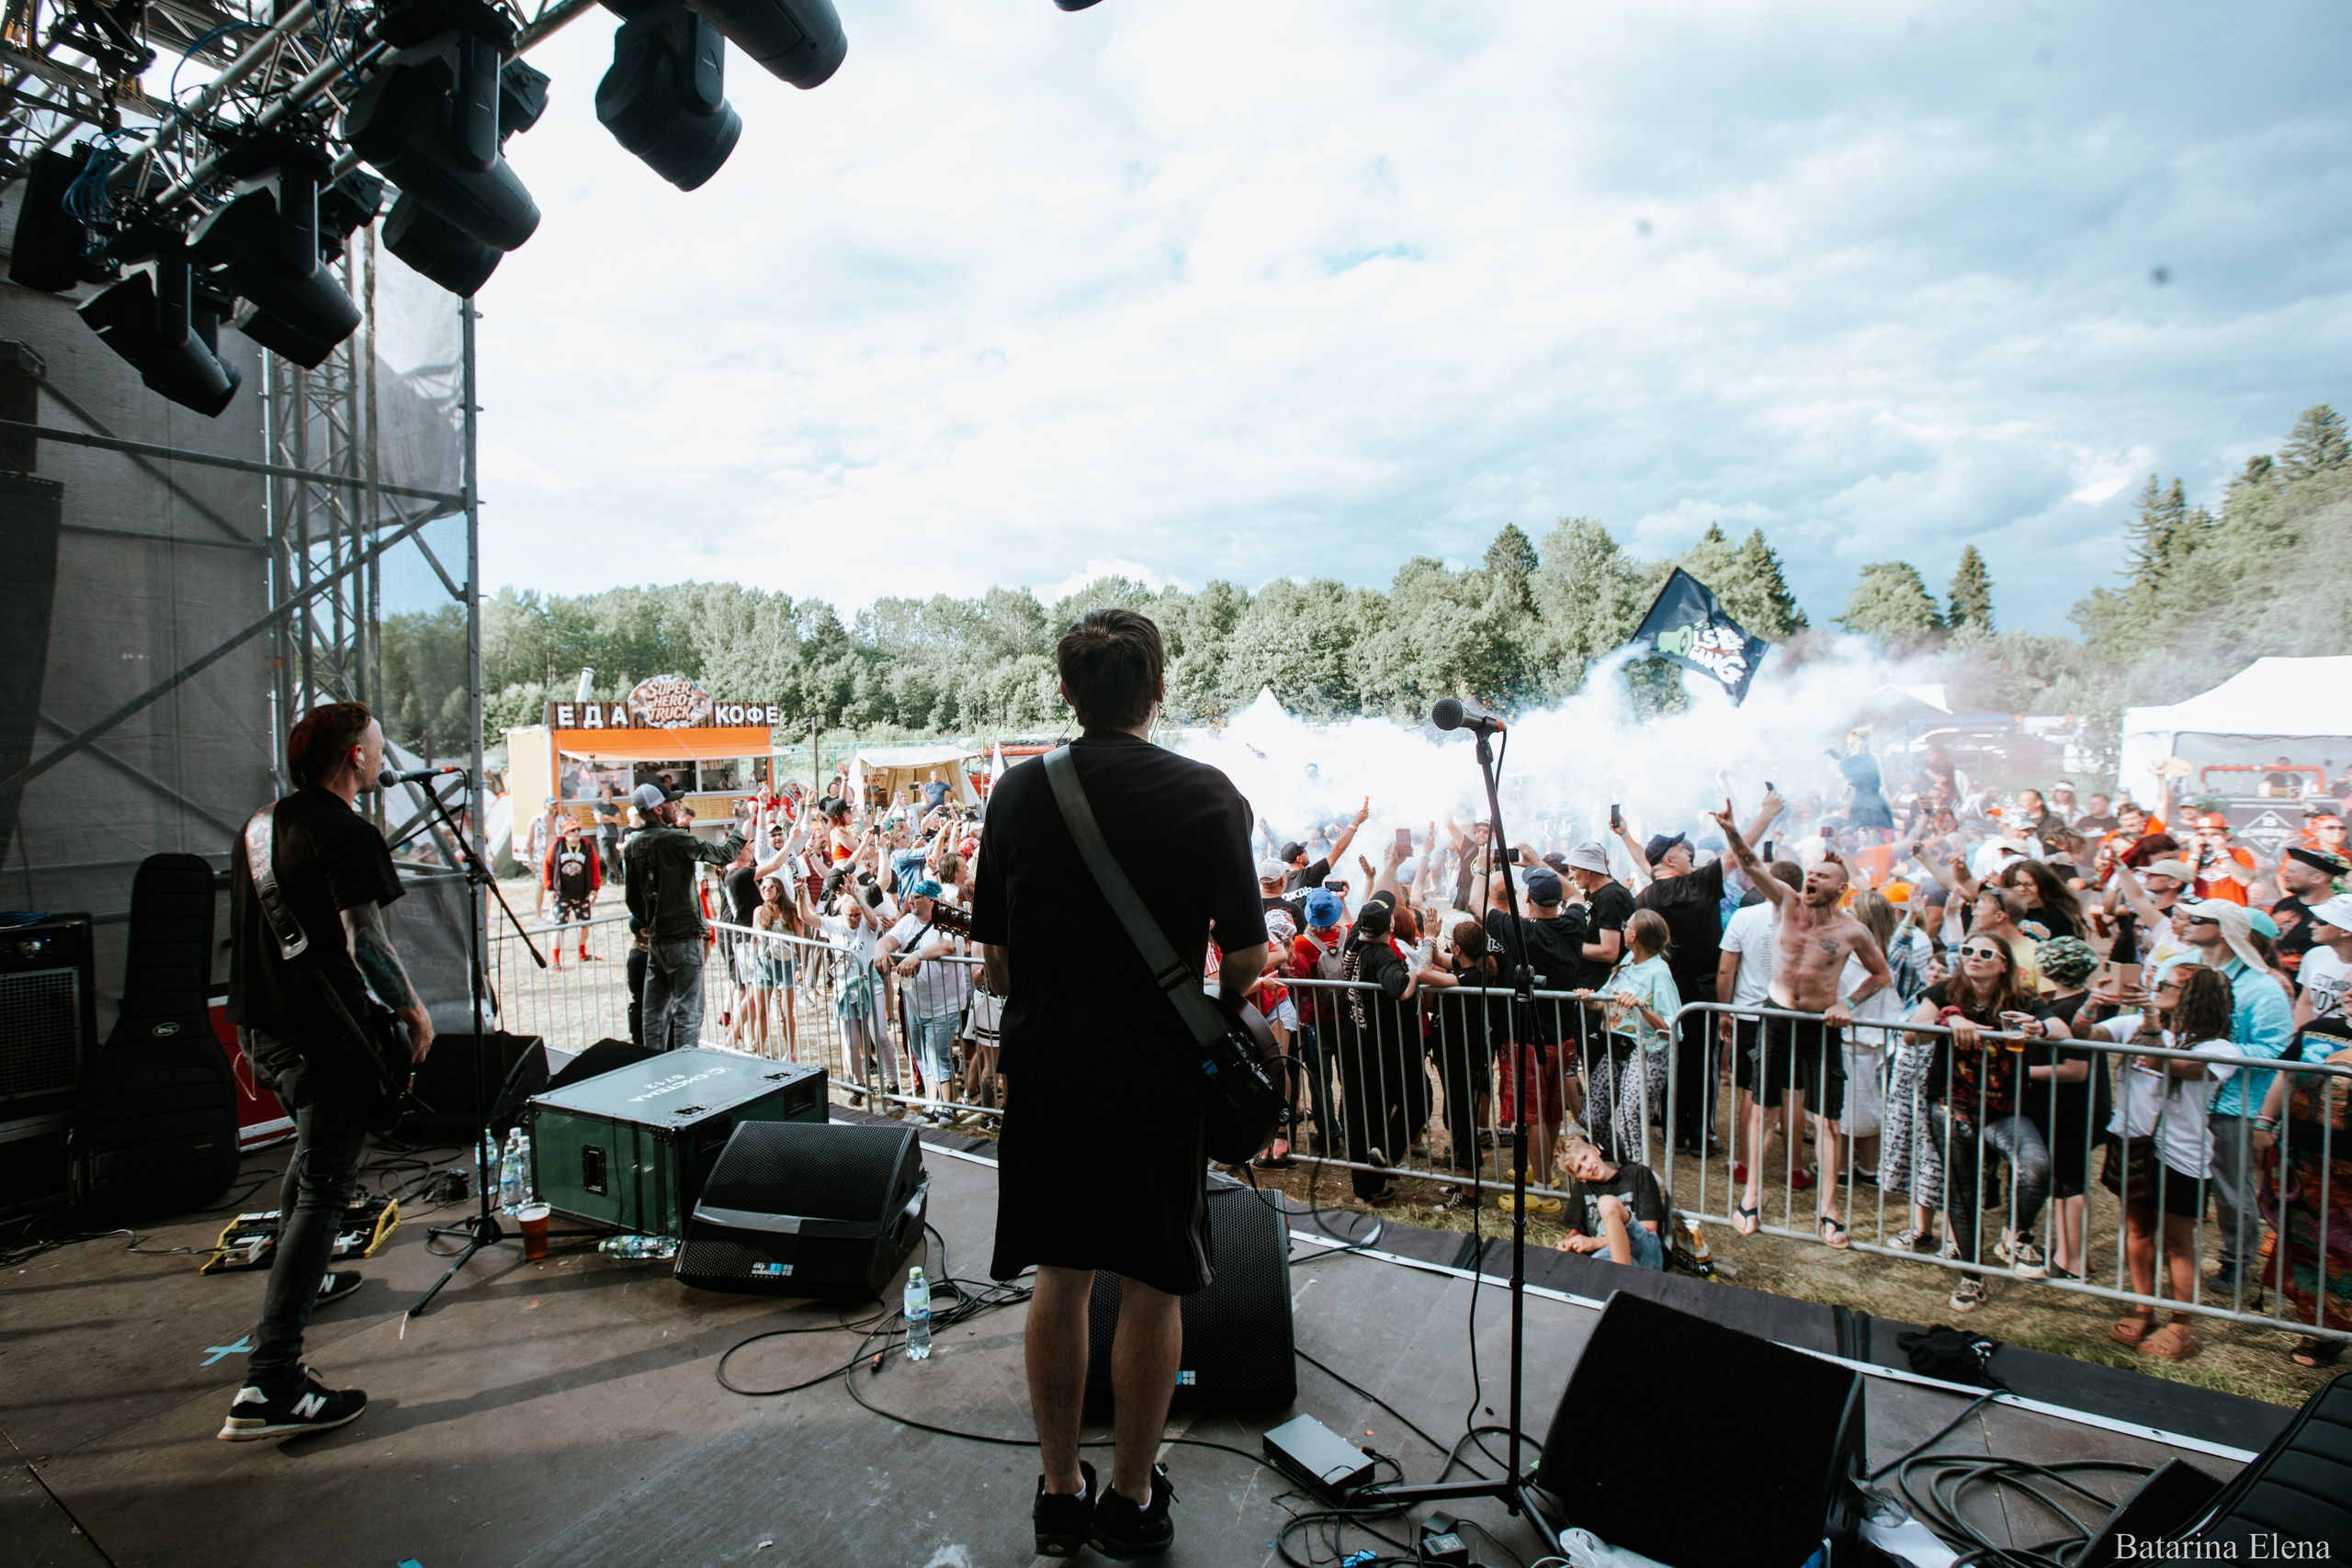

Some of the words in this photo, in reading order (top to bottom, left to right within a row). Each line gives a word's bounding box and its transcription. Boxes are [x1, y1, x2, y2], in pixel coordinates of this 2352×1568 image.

[647, 681, 691, 699] SUPER
[653, 694, 687, 707] HERO
[557, 705, 629, 728] ЕДА
[647, 705, 692, 723] TRUCK
[715, 705, 779, 724] КОФЕ
[290, 1392, 328, 1419] N
